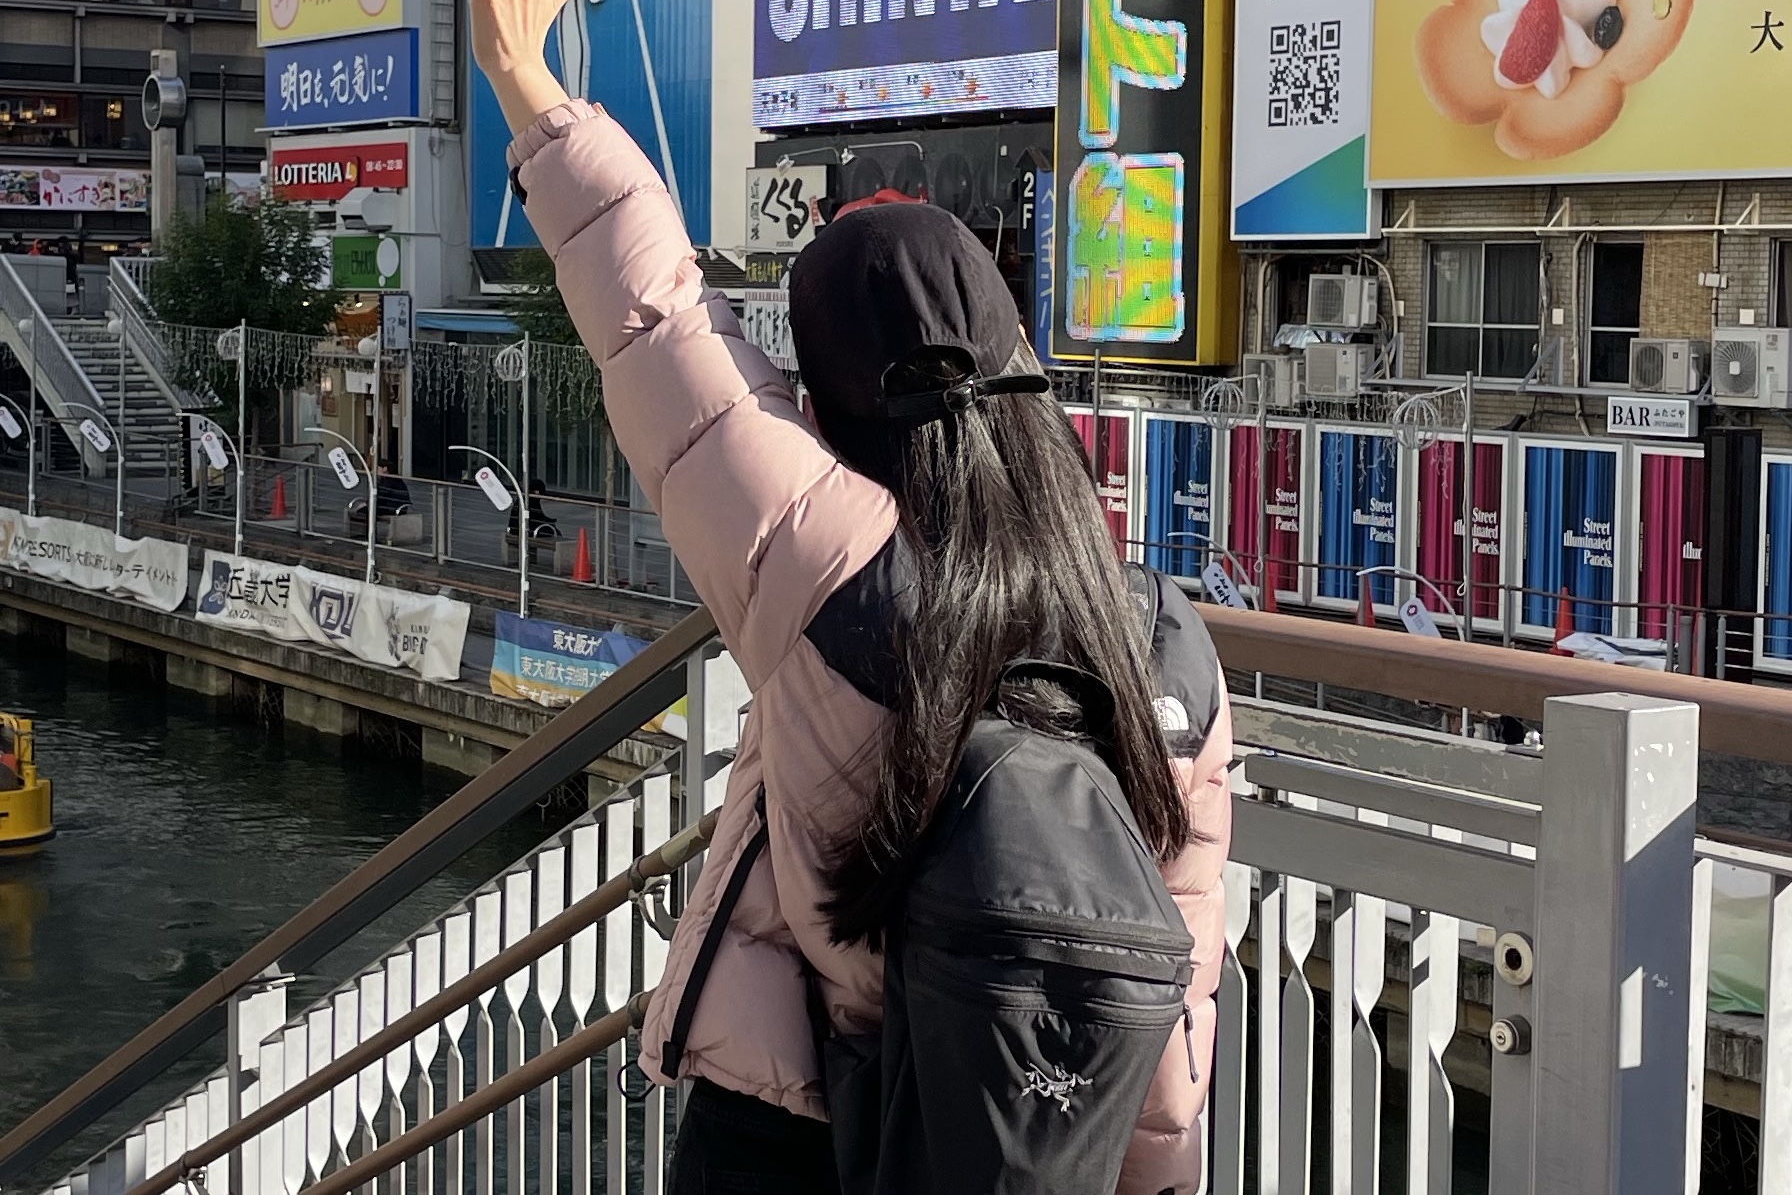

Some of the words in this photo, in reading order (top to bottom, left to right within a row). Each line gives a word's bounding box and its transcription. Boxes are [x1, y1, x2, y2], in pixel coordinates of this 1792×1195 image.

[1749, 10, 1785, 55] 大
[275, 162, 343, 186] LOTTERIA
[1023, 171, 1034, 230] 2F
[1612, 405, 1651, 427] BAR
[1370, 497, 1393, 514] Street
[1472, 507, 1498, 524] Street
[1583, 517, 1611, 535] Street
[1563, 529, 1612, 551] illuminated
[1583, 549, 1613, 568] Panels.
